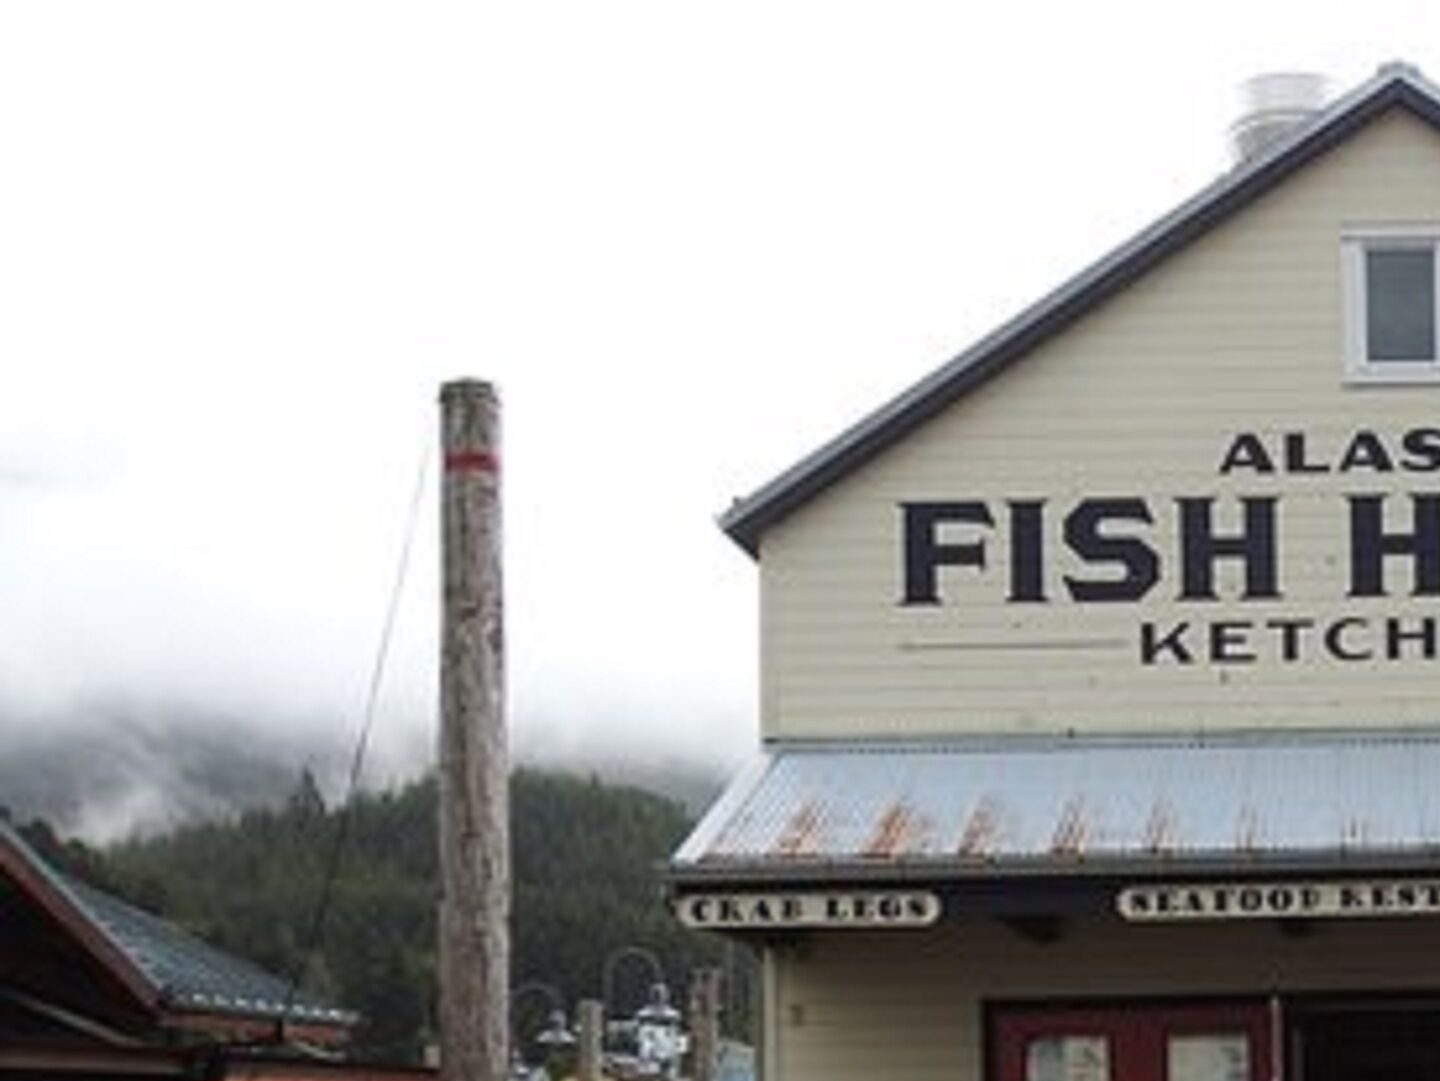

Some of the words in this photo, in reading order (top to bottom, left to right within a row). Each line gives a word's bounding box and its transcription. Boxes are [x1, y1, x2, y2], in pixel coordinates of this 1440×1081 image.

[898, 496, 1282, 607] FISH
[691, 898, 803, 922] CRAB
[825, 897, 930, 919] LEGS
[1130, 886, 1321, 912] SEAFOOD
